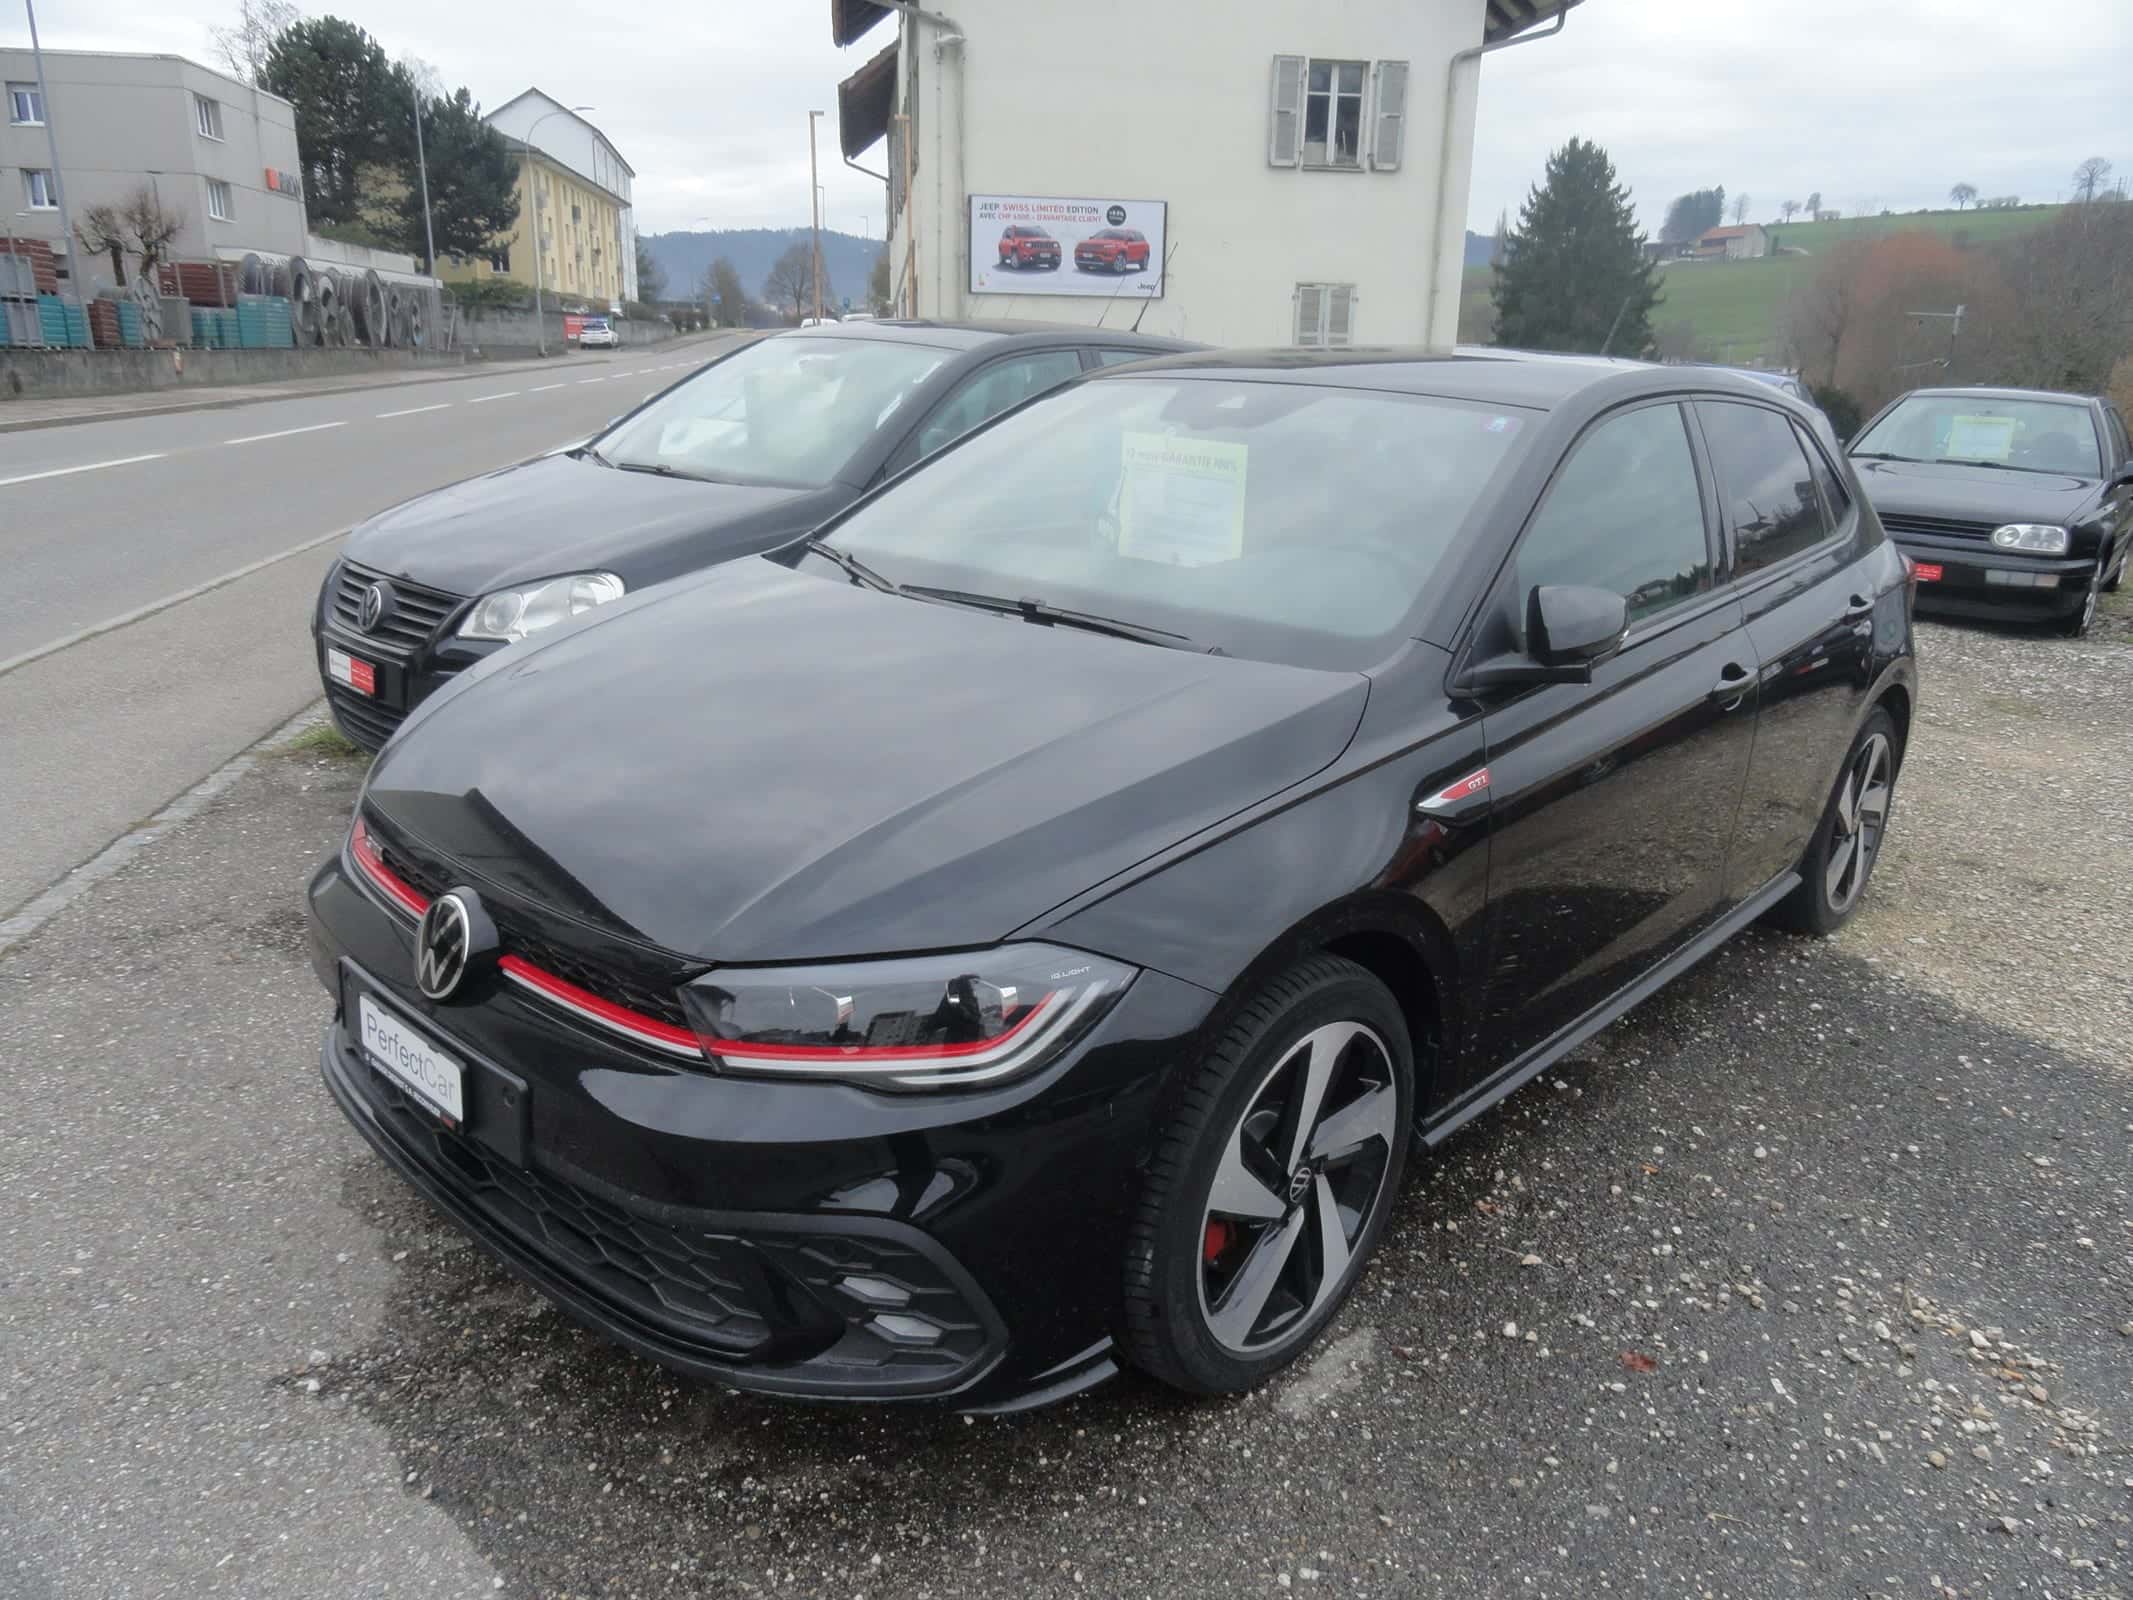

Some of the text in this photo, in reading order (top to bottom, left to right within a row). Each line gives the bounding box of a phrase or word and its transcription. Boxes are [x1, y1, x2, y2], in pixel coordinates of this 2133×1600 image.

[979, 202, 1099, 215] JEEP SWISS LIMITED EDITION
[1078, 214, 1103, 223] CLIENT
[1467, 775, 1486, 790] GTI
[366, 1013, 456, 1101] PerfectCar
